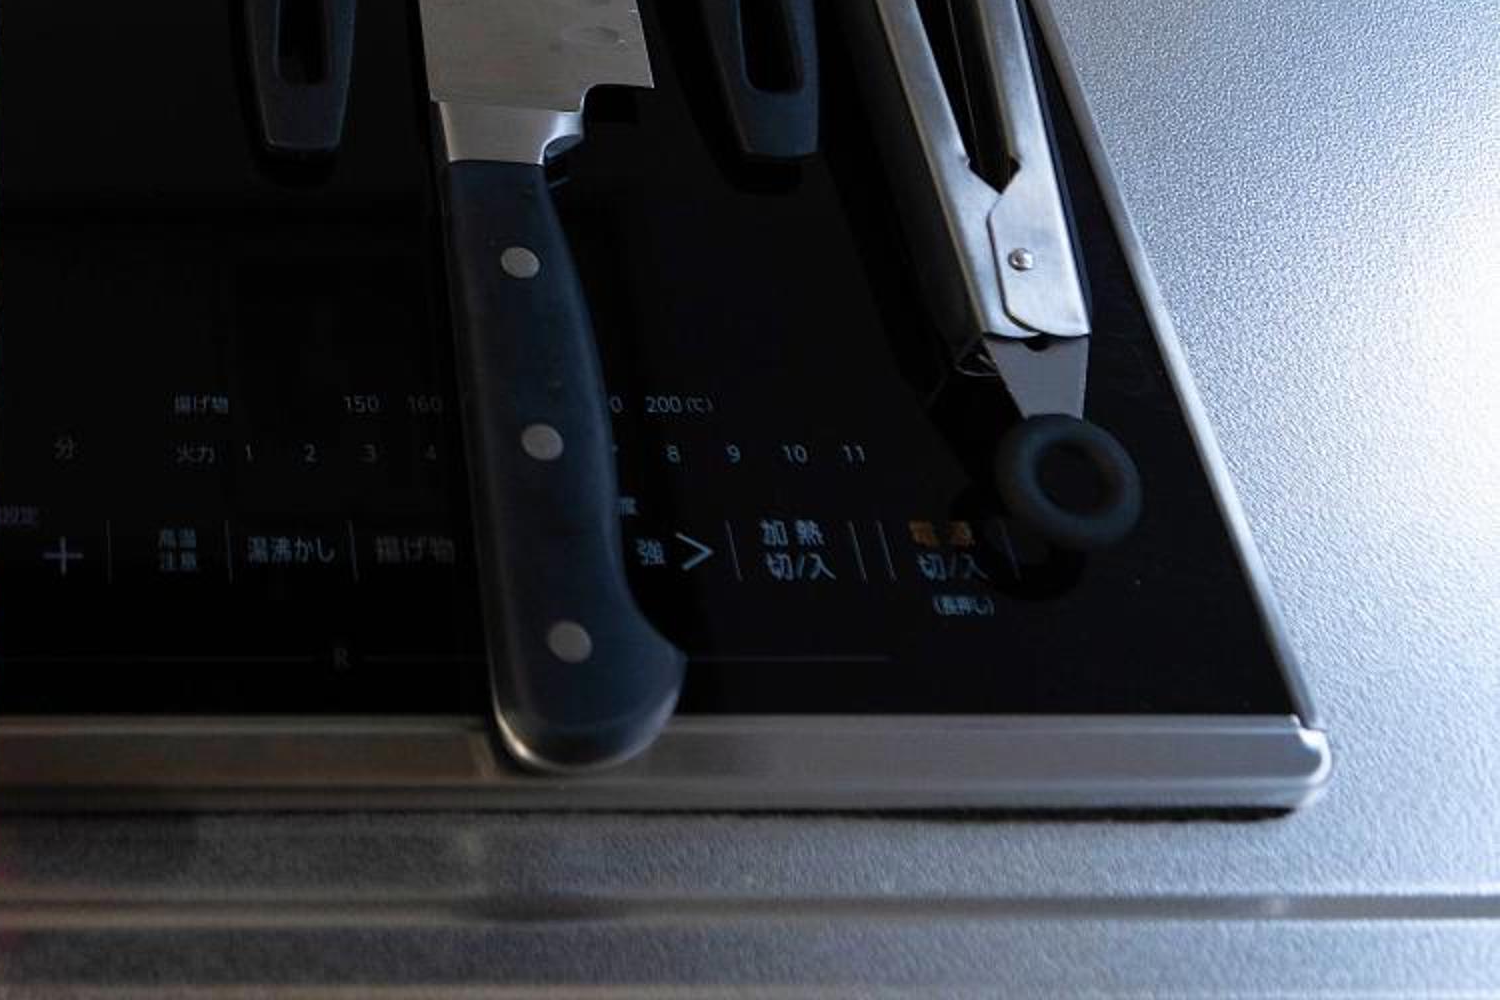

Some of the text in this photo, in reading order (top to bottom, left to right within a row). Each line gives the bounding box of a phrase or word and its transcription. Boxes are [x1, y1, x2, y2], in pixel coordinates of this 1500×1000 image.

[345, 395, 379, 413] 150
[407, 395, 442, 413] 160
[176, 443, 215, 464] 火力
[244, 442, 254, 464] 1
[304, 443, 317, 463] 2
[361, 444, 377, 464] 3
[666, 445, 865, 464] 8 9 10 11
[760, 520, 826, 548] 加熱
[247, 537, 336, 564] 湯沸かし
[374, 537, 456, 564] 揚げ物
[766, 554, 836, 581] 切/入
[917, 554, 989, 581] 切/入
